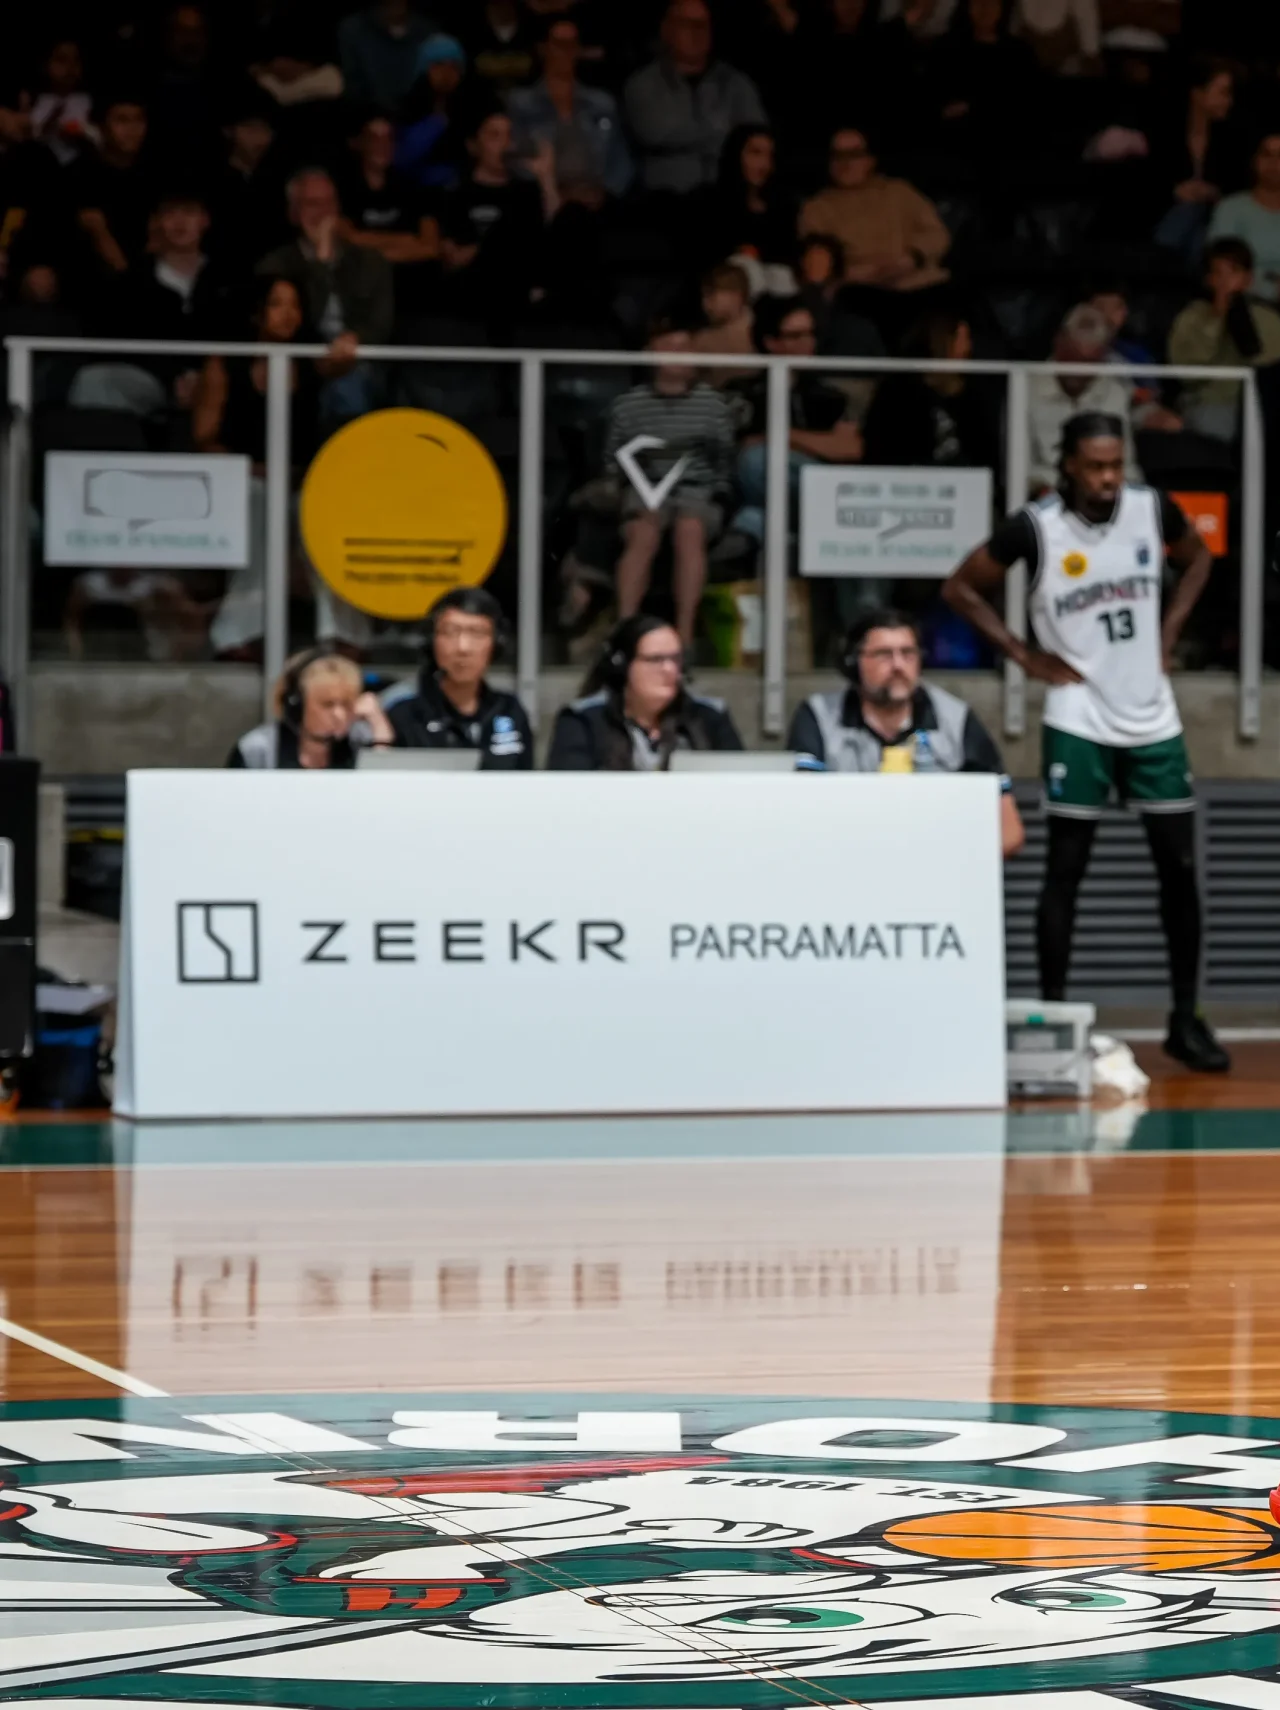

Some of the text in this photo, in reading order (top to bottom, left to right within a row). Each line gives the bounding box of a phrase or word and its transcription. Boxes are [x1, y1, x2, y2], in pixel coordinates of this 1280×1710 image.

[1098, 608, 1134, 643] 13
[301, 920, 964, 963] ZEEKR PARRAMATTA
[685, 1476, 1020, 1503] EST. 1984
